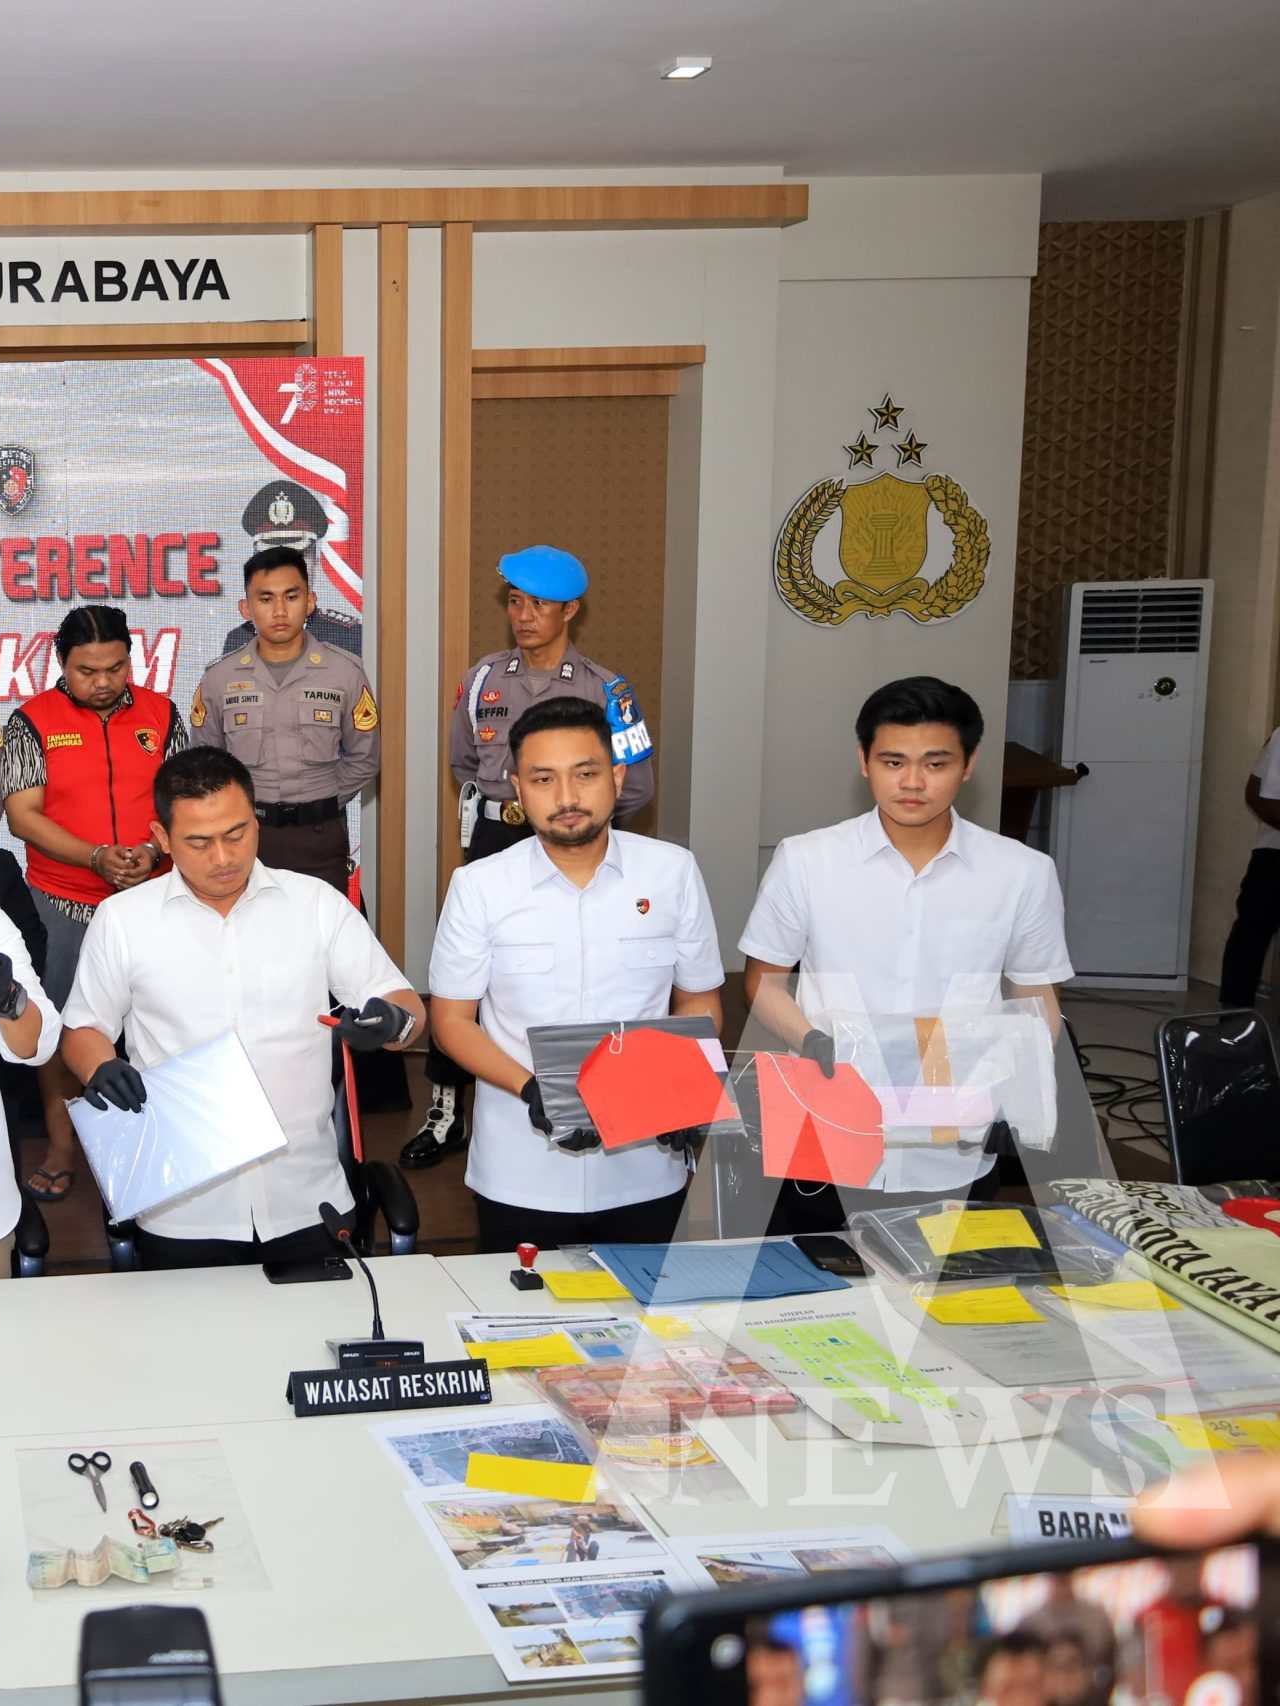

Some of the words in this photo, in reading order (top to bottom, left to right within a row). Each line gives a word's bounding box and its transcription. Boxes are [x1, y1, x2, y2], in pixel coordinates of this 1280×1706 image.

[304, 690, 341, 702] TARUNA
[477, 707, 509, 719] EFFRI
[47, 733, 81, 742] TAHANAN
[47, 740, 83, 751] JATANRAS
[304, 1376, 391, 1406] WAKASAT
[399, 1368, 486, 1399] RESKRIM
[1038, 1509, 1130, 1540] BARAN
